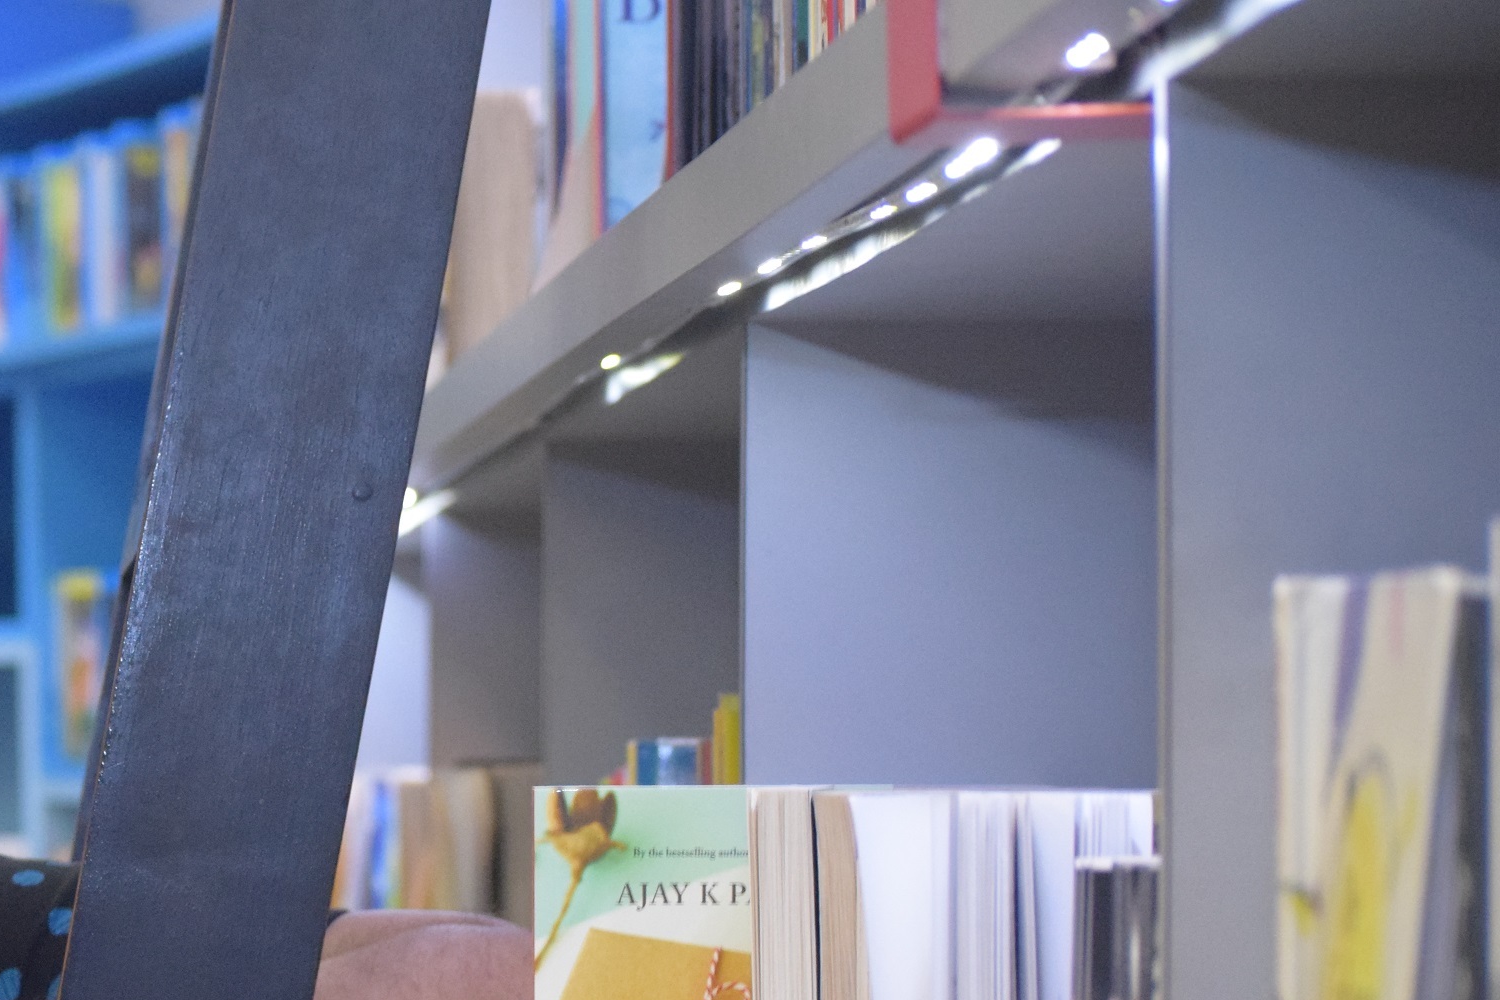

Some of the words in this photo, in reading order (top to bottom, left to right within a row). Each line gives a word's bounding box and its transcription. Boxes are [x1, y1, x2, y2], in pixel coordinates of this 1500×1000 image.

[633, 847, 646, 859] By
[648, 847, 664, 857] the
[665, 846, 716, 860] bestselling
[617, 881, 690, 911] AJAY
[700, 882, 719, 906] K
[729, 882, 751, 906] P
